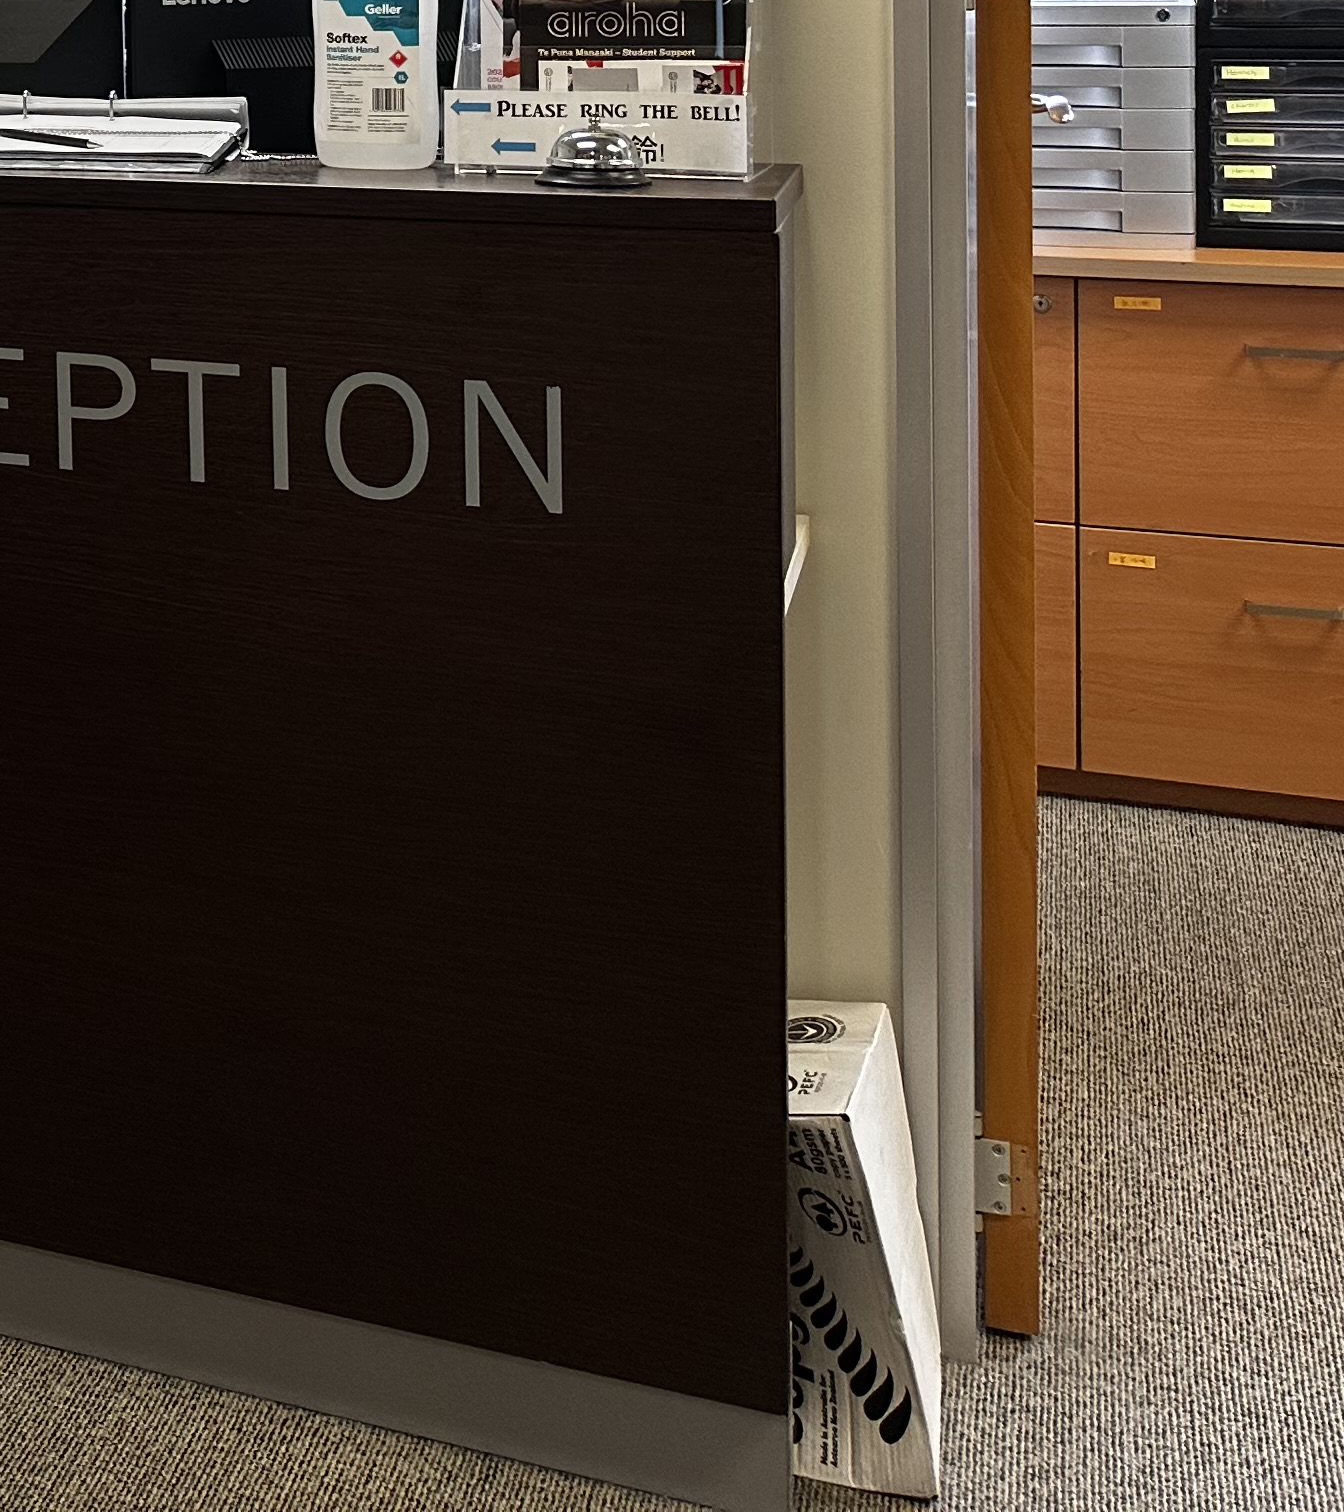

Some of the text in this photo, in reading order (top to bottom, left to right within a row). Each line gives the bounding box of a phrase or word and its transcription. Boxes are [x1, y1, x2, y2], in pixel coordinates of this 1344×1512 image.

[364, 3, 403, 16] Geller
[547, 1, 684, 38] aroha
[326, 31, 368, 44] Softex
[327, 45, 353, 53] Instant
[659, 49, 695, 58] Support
[496, 100, 741, 122] PLEASE RING THE BELL!
[797, 1070, 819, 1095] PEFC
[802, 1129, 827, 1175] 80gsm
[841, 1194, 866, 1245] PEFC
